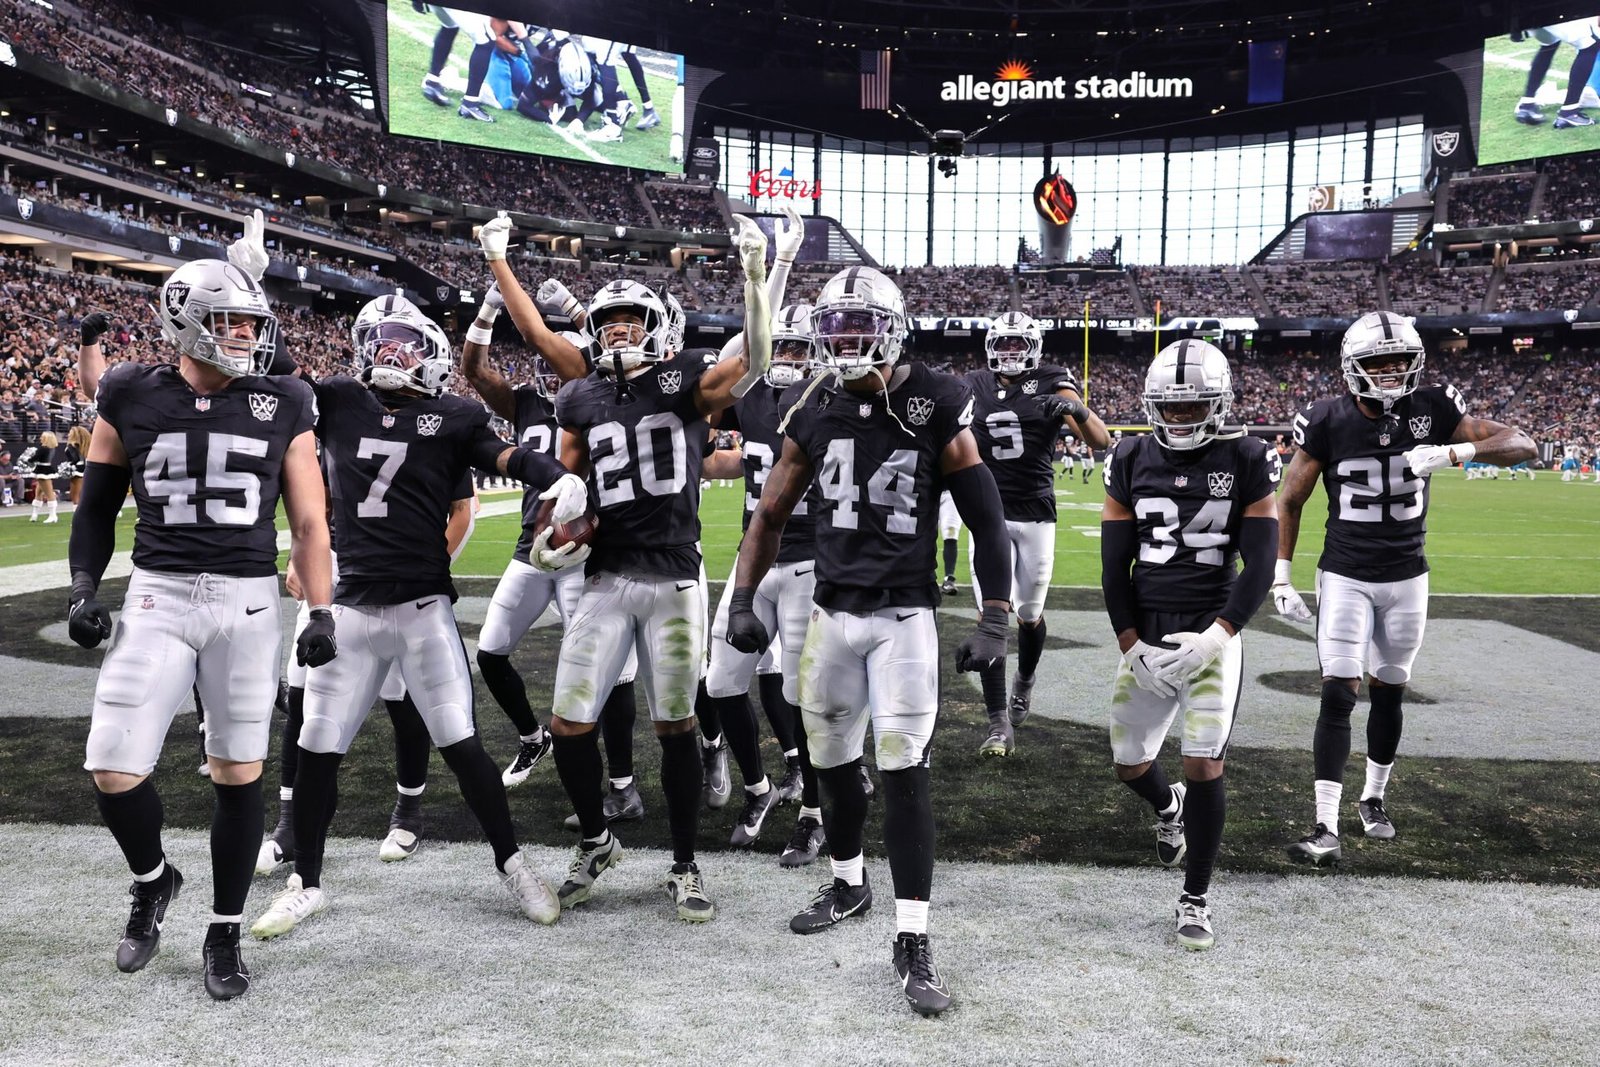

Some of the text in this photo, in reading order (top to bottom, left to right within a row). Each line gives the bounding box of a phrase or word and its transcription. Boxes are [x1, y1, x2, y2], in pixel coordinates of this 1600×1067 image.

[940, 71, 1193, 107] allegiant stadium
[747, 168, 823, 199] Coors
[1064, 319, 1079, 328] 1ST
[1088, 319, 1098, 328] 10
[1106, 319, 1119, 328] ON
[588, 412, 687, 508] 20
[985, 411, 1025, 460] 9
[144, 432, 269, 525] 45
[356, 437, 409, 518] 7
[743, 441, 814, 515] 3
[819, 438, 919, 534] 44
[1337, 455, 1426, 522] 25
[1135, 497, 1233, 567] 34
